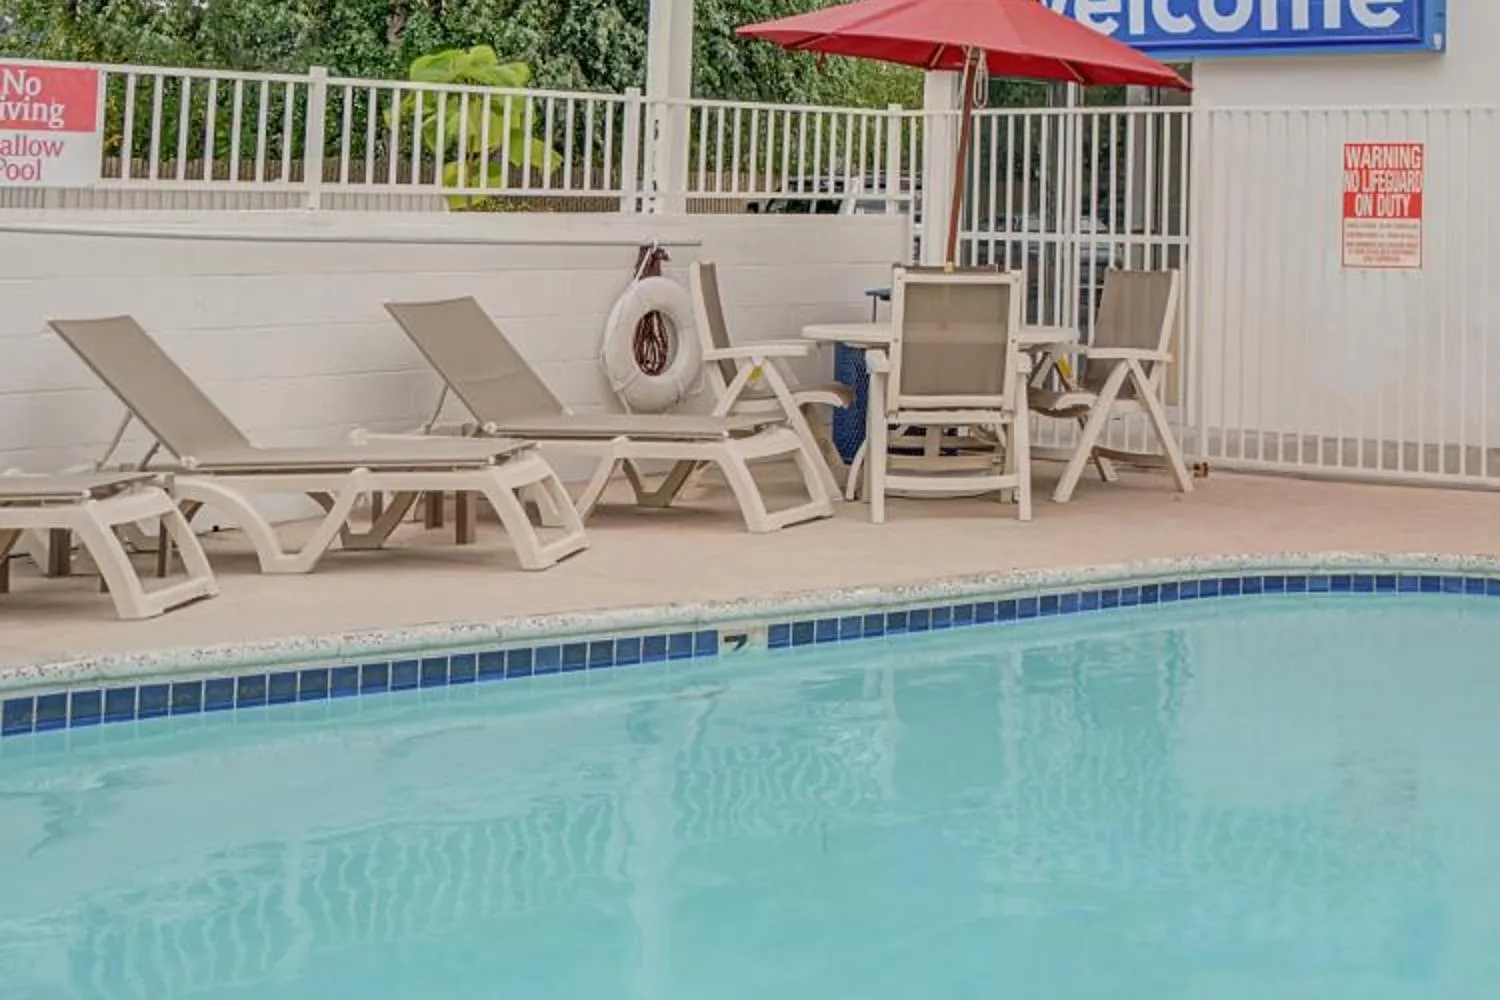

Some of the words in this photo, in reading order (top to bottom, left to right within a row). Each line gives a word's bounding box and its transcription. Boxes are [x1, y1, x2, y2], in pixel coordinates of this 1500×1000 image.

[2, 67, 42, 96] No
[1345, 146, 1421, 169] WARNING
[1355, 193, 1373, 216] ON
[1376, 193, 1411, 216] DUTY
